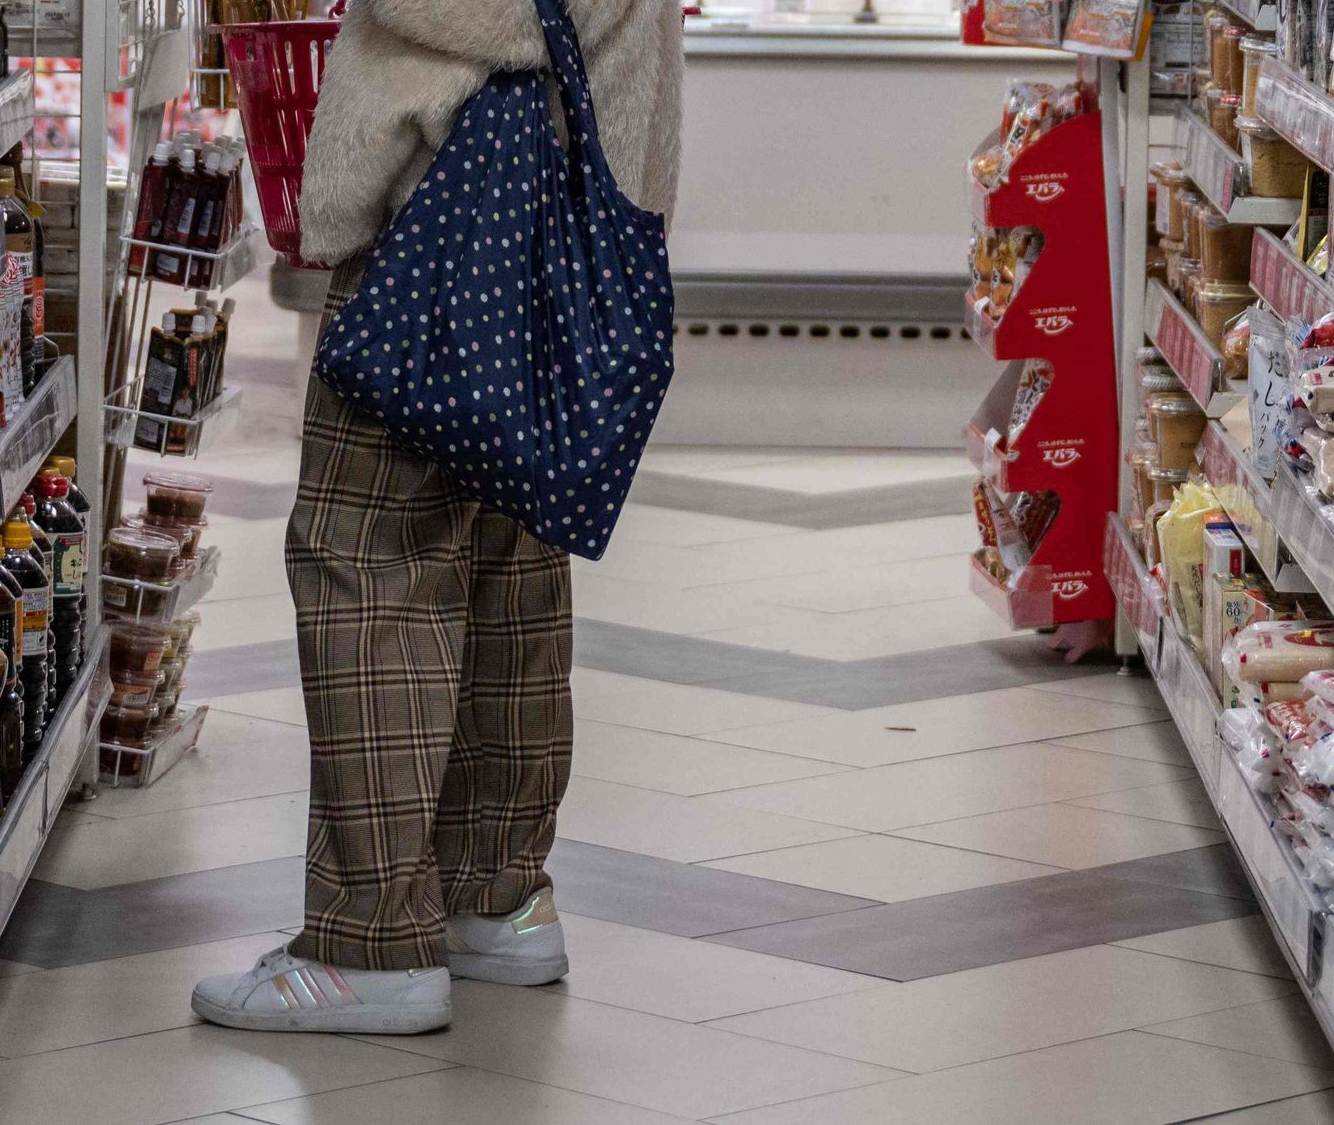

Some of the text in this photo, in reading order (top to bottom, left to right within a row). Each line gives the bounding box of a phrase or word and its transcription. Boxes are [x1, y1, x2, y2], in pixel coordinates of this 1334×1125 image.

[1025, 182, 1066, 200] エバラ
[1034, 315, 1075, 333] エバラ
[1042, 447, 1082, 465] エバラ
[1051, 579, 1089, 596] エバラ
